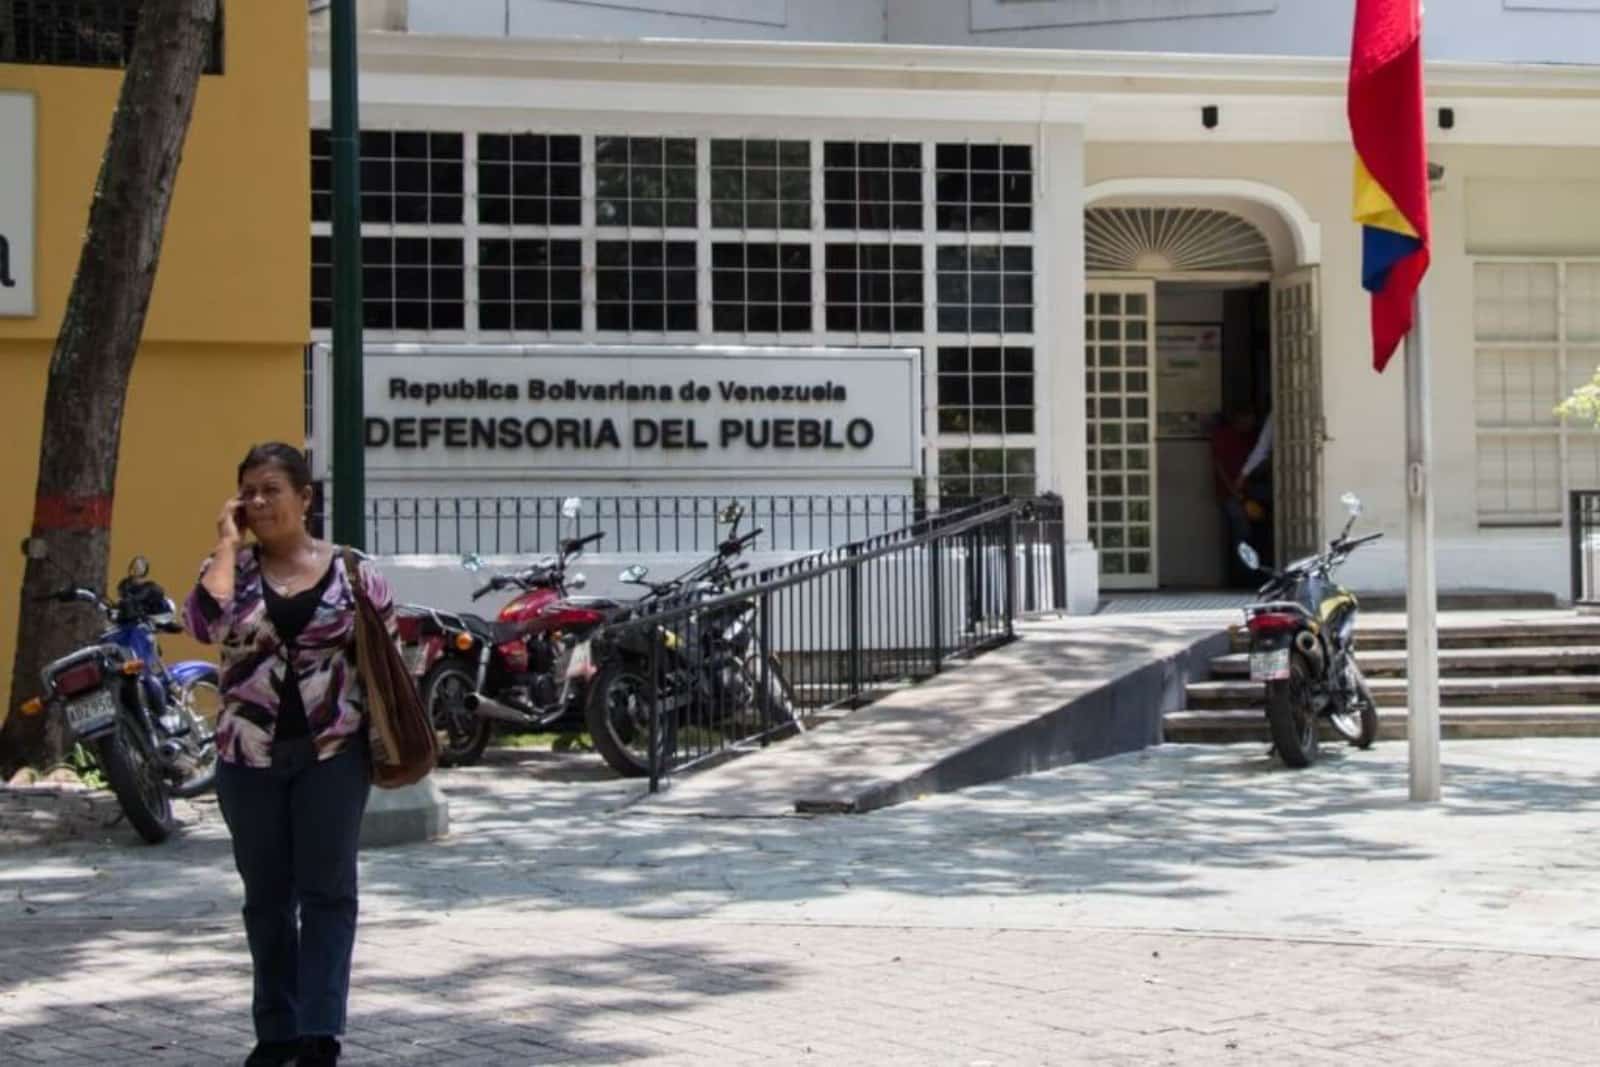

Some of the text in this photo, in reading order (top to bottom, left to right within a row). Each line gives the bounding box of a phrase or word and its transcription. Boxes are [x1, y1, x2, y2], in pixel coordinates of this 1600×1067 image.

[388, 377, 847, 406] Republica Bolivariana de Venezuela
[365, 416, 874, 451] DEFENSORIA DEL PUEBLO
